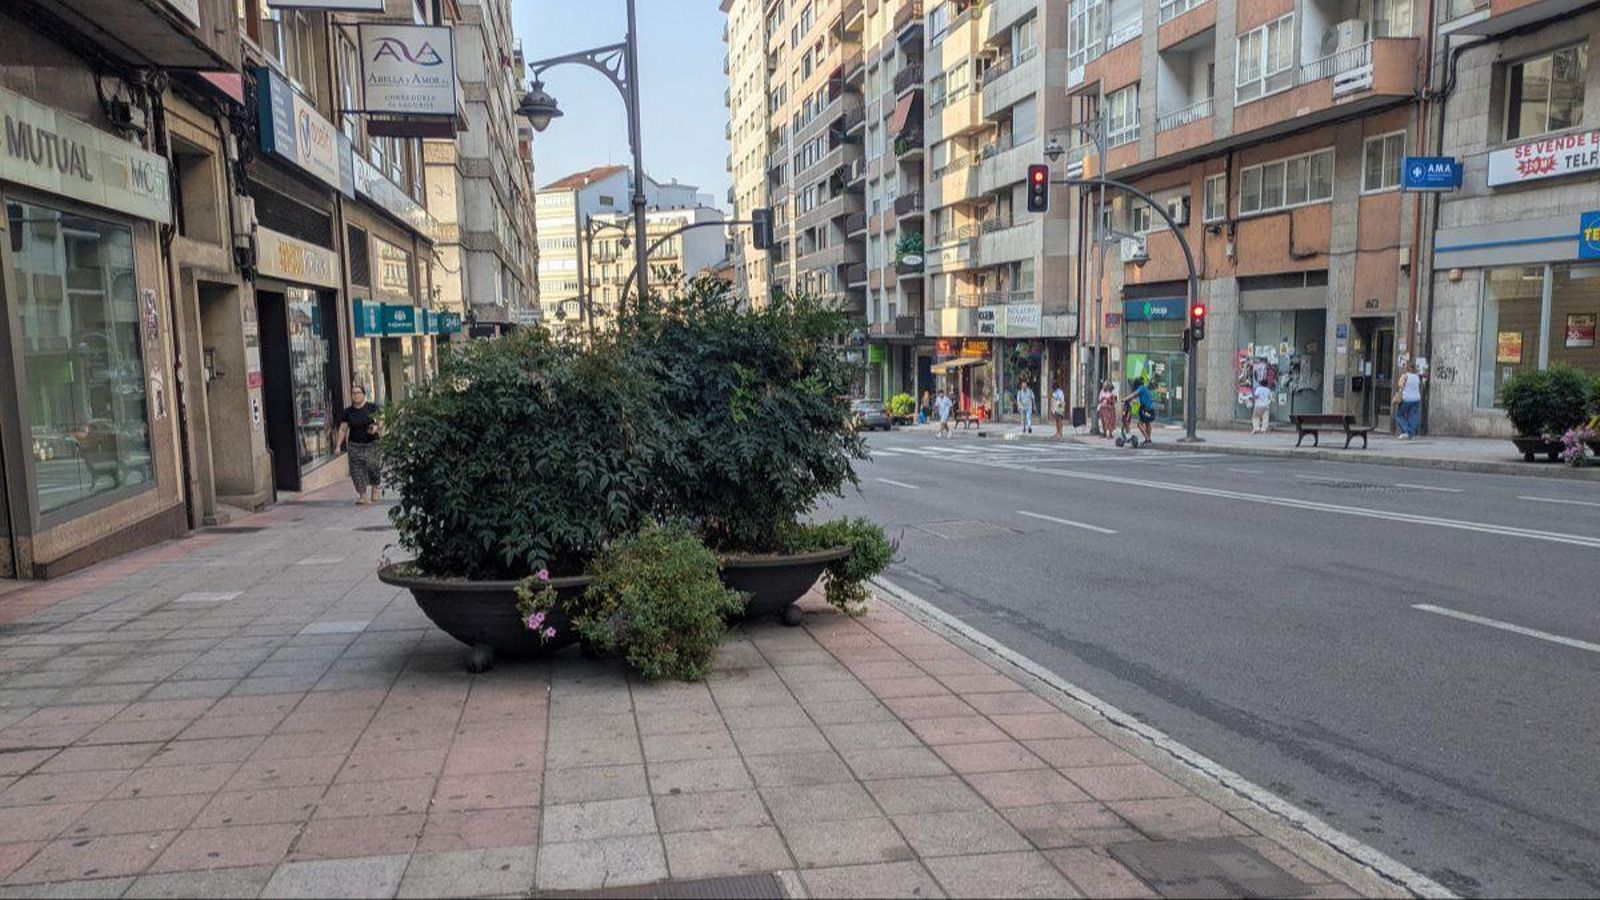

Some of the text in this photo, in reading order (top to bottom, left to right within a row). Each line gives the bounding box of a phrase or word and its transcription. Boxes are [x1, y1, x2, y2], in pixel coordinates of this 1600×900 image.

[412, 74, 439, 84] AMOR
[4, 114, 94, 182] MUTUAL
[1515, 144, 1531, 159] SE
[1536, 133, 1585, 154] VENDE
